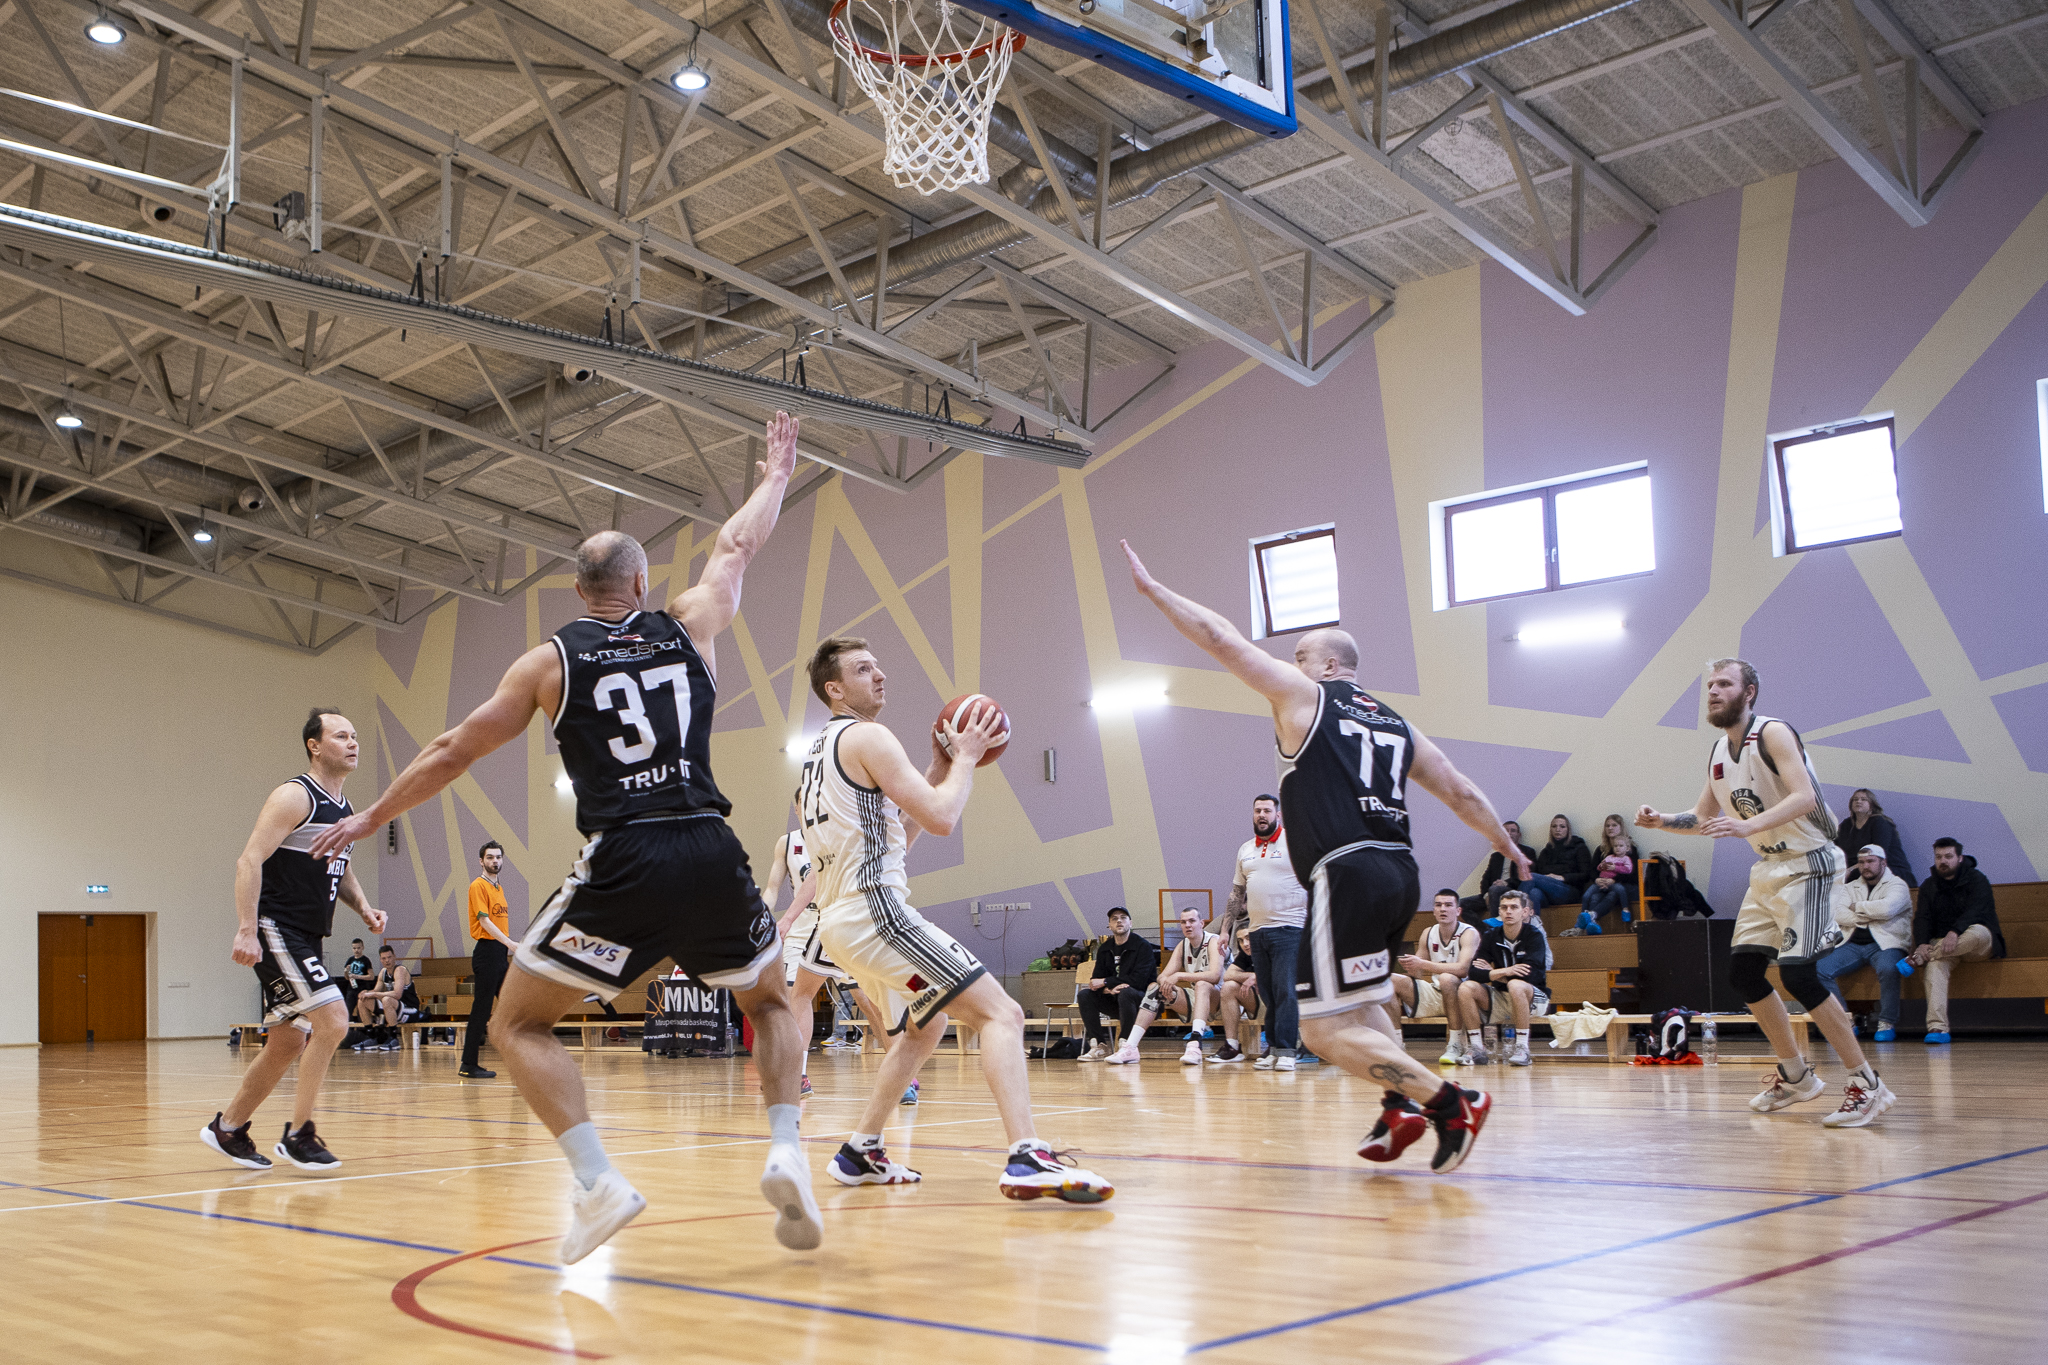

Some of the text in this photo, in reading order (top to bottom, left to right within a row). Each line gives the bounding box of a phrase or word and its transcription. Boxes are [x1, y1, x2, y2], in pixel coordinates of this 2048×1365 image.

[597, 637, 682, 660] medsport
[592, 662, 691, 765] 37
[1338, 719, 1407, 801] 77
[329, 877, 339, 902] 5
[302, 955, 329, 983] 5
